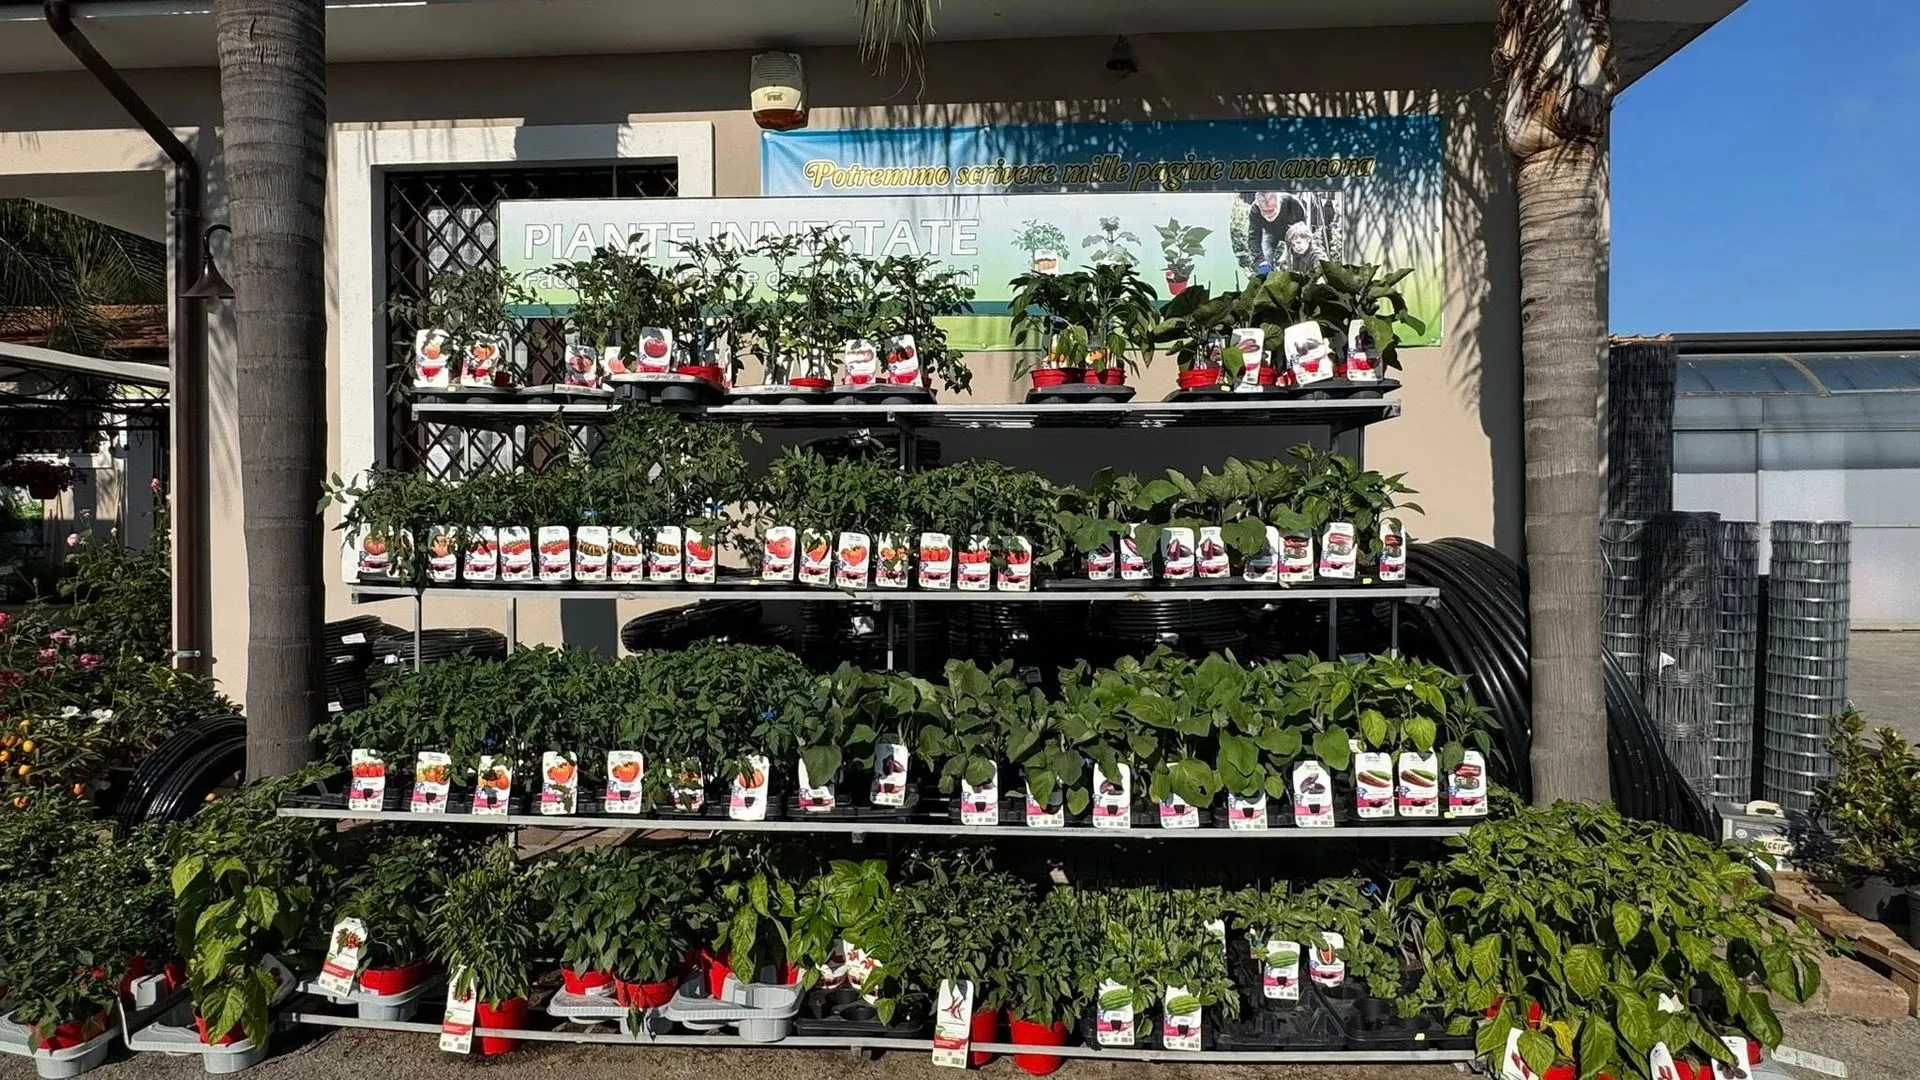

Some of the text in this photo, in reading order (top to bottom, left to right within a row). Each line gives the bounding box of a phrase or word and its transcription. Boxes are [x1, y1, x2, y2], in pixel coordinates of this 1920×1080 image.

[804, 154, 1376, 191] Potremmo scrivere mille pagine ma ancora
[523, 219, 980, 260] PIANTE INNESTATE
